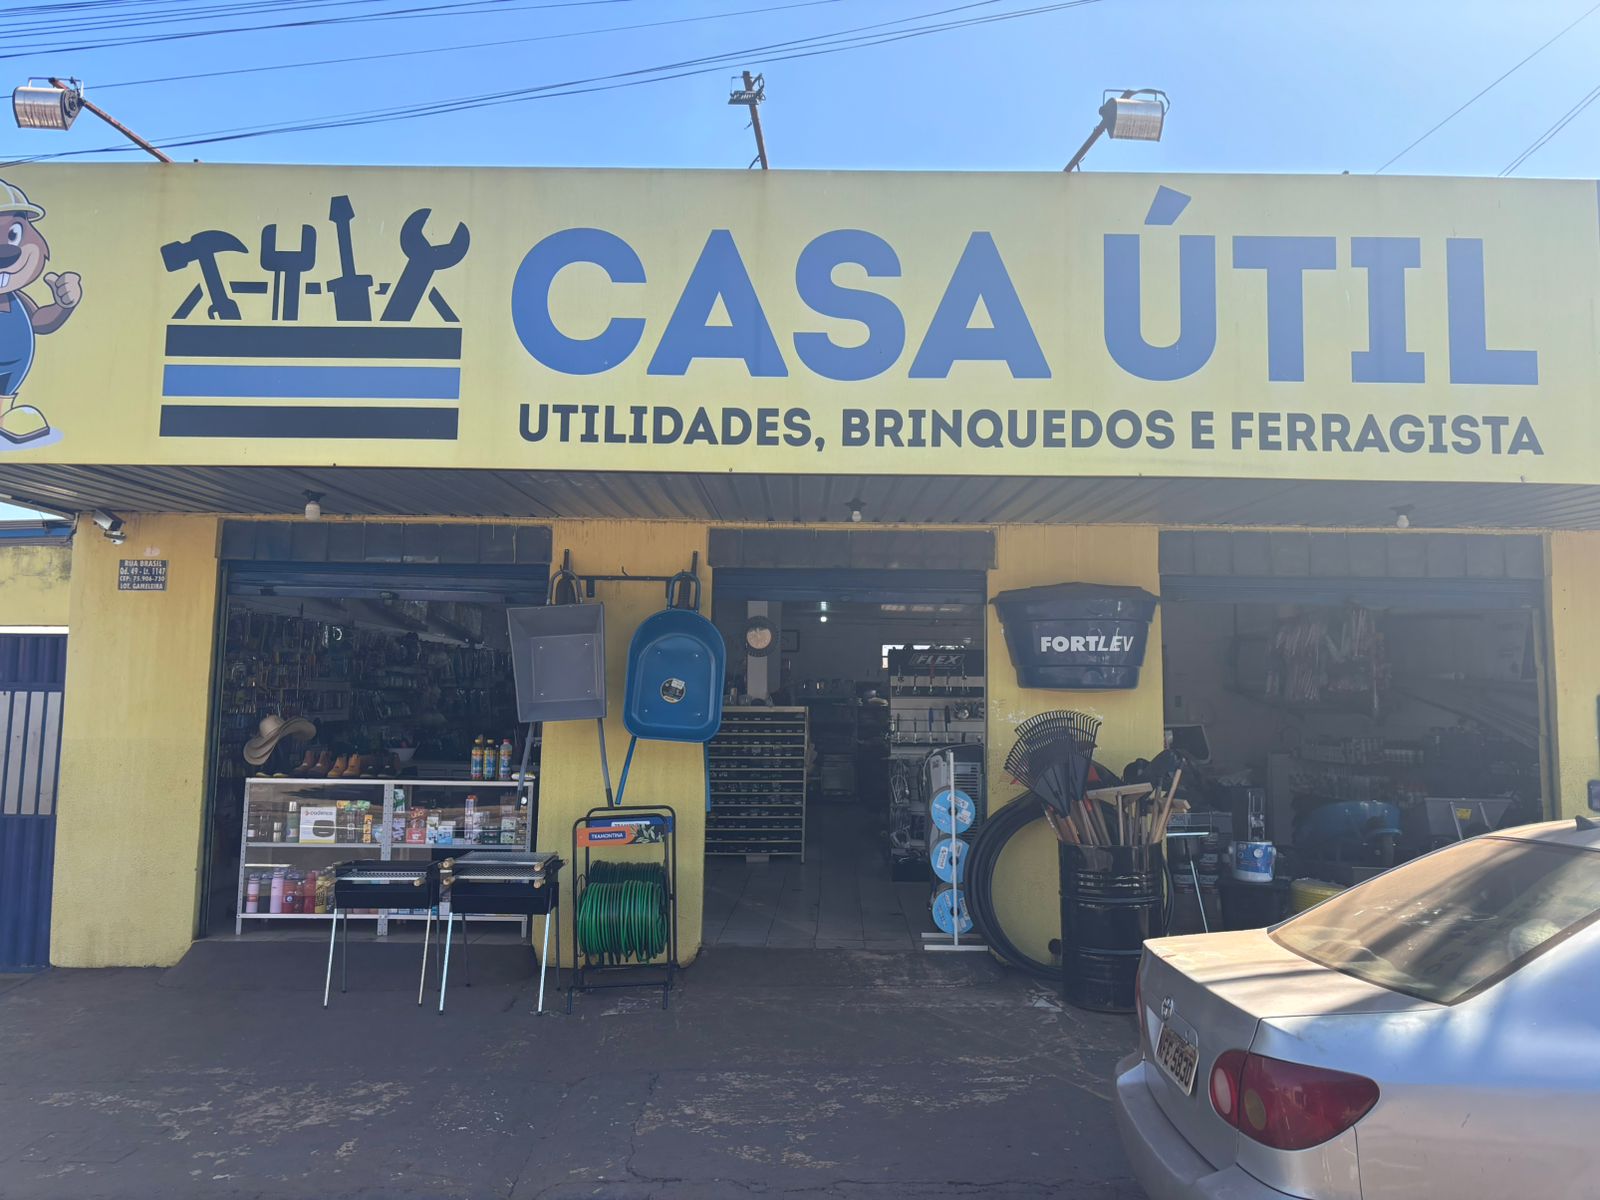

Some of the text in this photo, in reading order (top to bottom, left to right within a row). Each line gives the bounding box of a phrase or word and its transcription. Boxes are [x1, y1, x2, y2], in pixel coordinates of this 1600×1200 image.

[511, 185, 1539, 386] CASA ÚTIL
[518, 403, 1545, 456] UTILIDADES, BRINQUEDOS E FERRAGISTA
[1040, 635, 1134, 652] FORTLEV
[591, 832, 624, 841] TRAMONTINA
